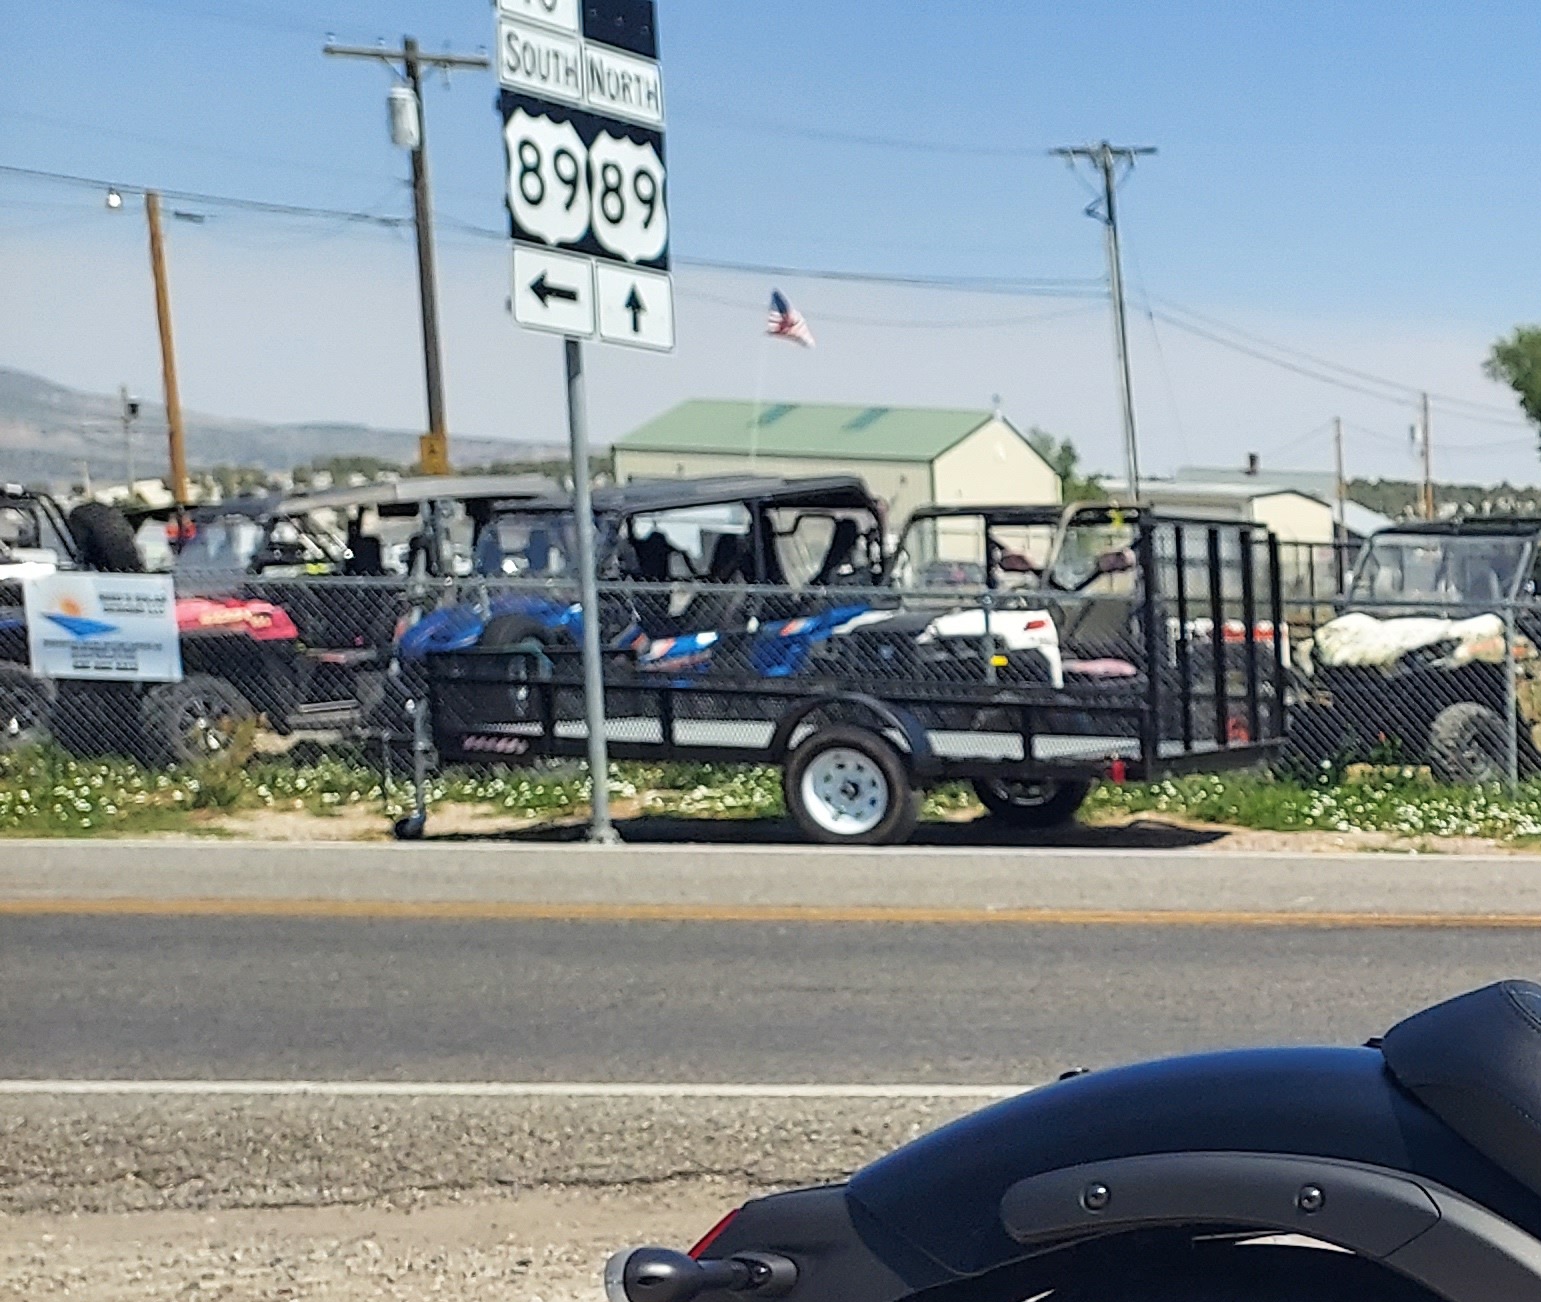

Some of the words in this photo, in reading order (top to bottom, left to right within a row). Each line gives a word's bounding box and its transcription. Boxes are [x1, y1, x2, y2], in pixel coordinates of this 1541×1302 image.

[506, 31, 579, 90] SOUTH
[589, 56, 660, 112] NORTH
[518, 139, 579, 212] 89
[601, 163, 657, 230] 89
